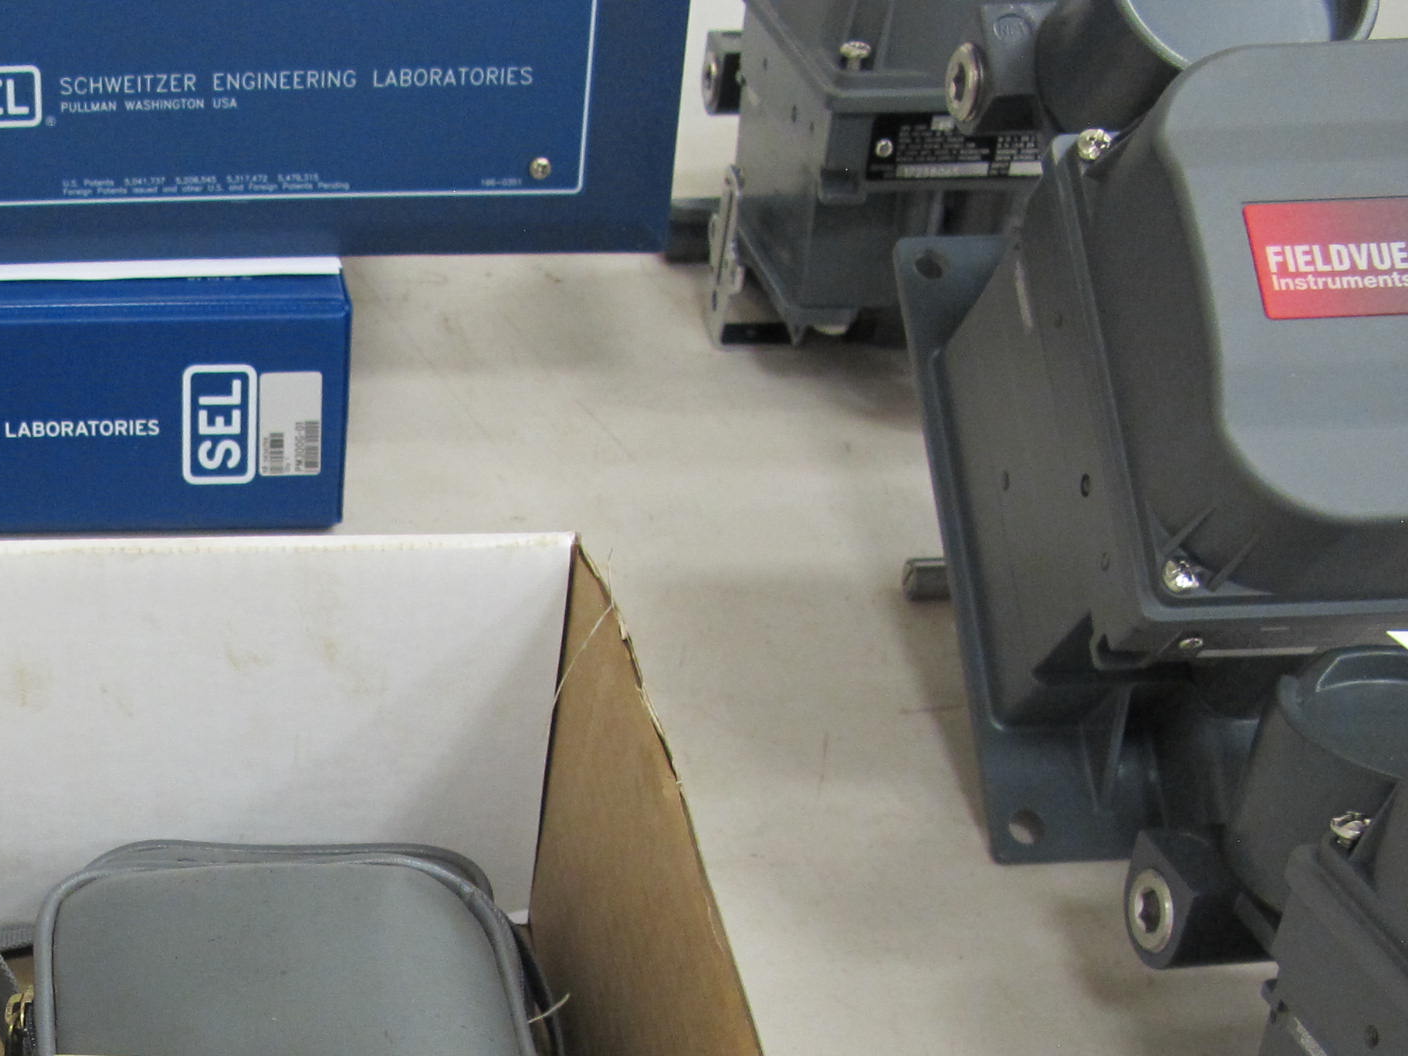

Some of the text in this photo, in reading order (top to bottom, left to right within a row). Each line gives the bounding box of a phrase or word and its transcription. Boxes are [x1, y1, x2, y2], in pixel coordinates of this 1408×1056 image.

[60, 66, 534, 95] SCHWEITZER ENGINEERING LABORATORIES
[61, 97, 238, 113] PULLMAN WASHINGTON USA
[1265, 242, 1408, 273] FIELDVUE
[1272, 272, 1408, 291] Instruments
[4, 418, 160, 439] LABORATORIES
[198, 379, 242, 470] SEL
